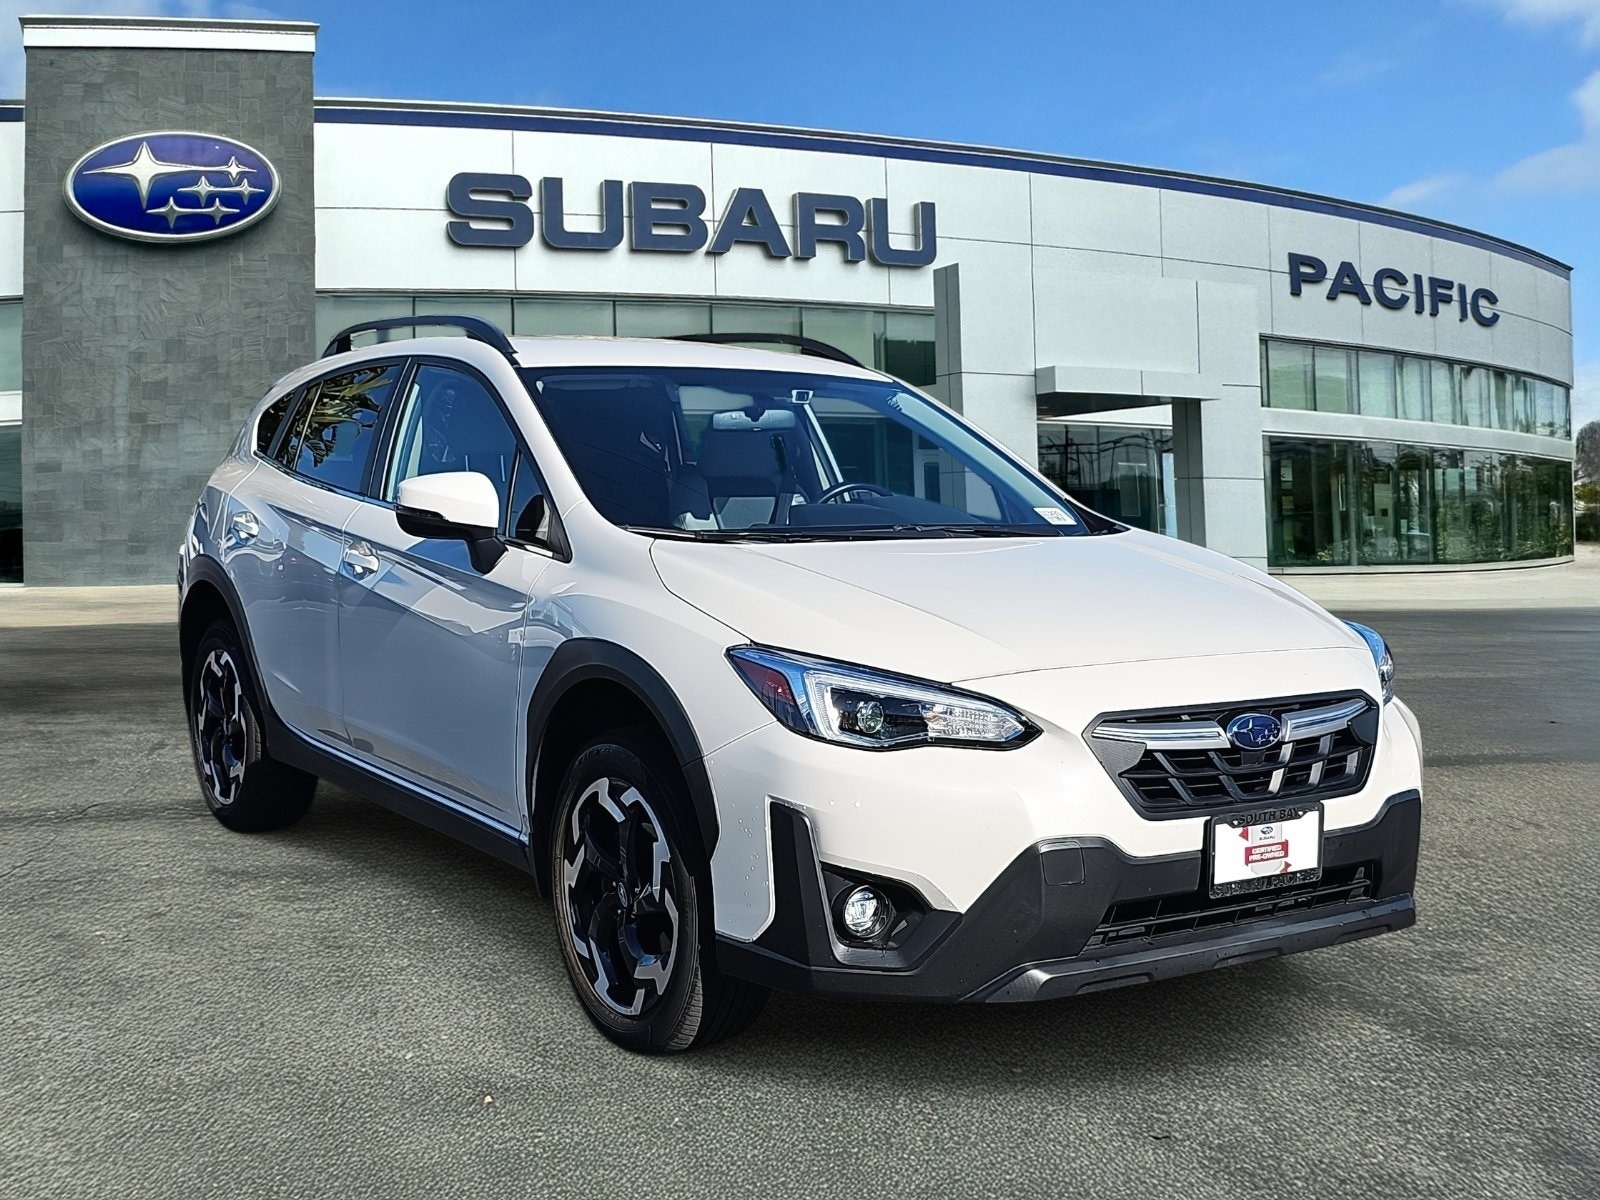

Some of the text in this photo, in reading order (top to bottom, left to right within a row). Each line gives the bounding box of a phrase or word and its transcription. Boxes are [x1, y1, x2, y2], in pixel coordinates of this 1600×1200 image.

[447, 172, 937, 267] SUBARU
[1288, 252, 1500, 327] PACIFIC
[1238, 807, 1300, 825] SOUTH BAY
[1249, 851, 1284, 861] PRE-OWNED
[1252, 845, 1282, 854] CERTIFIED
